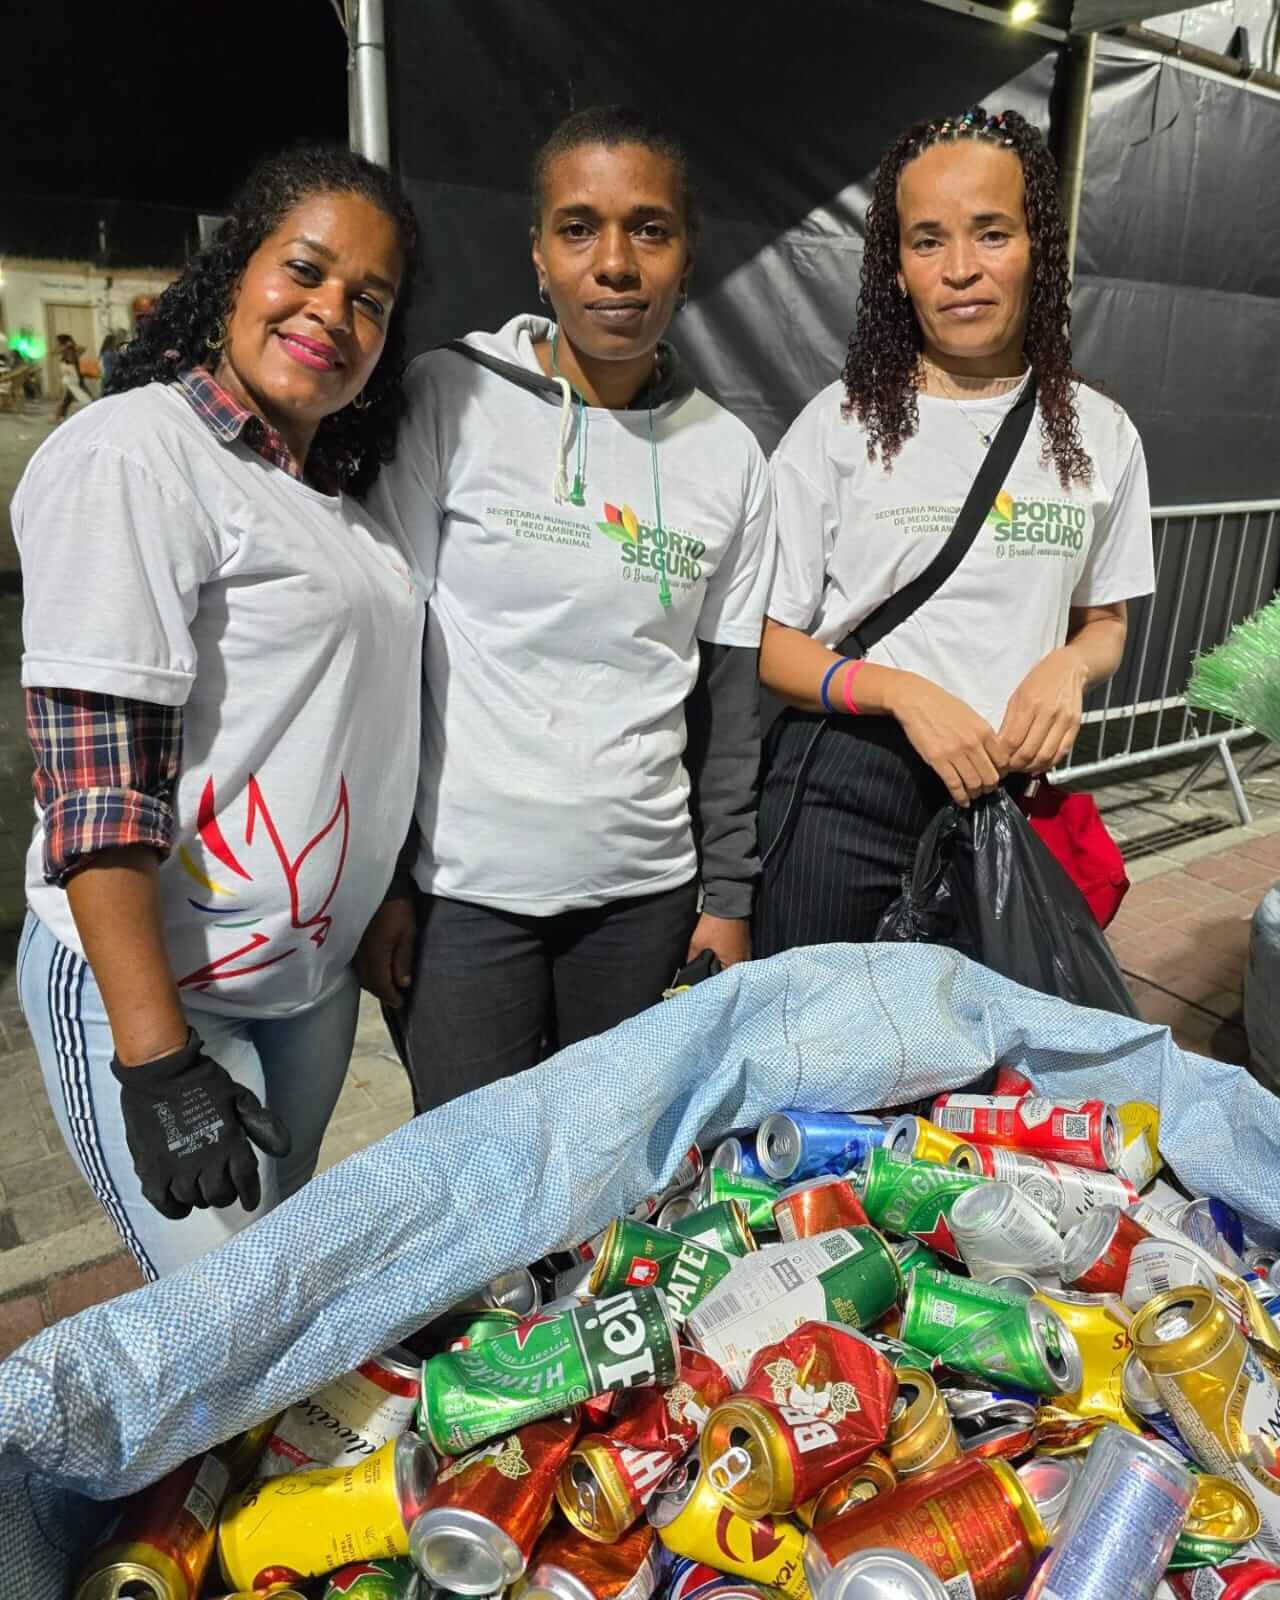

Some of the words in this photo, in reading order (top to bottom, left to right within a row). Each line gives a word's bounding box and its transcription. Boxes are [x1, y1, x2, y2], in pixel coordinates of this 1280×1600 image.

[486, 507, 541, 521] SECRETARIA
[543, 515, 591, 531] MUNICIPAL
[875, 505, 926, 520] SECRETARIA
[894, 517, 907, 526] DE
[908, 515, 931, 524] MEIO
[1012, 502, 1085, 529] PORTO
[506, 517, 519, 528] DE
[521, 520, 543, 531] MEIO
[545, 524, 591, 540] AMBIENTE
[523, 530, 554, 543] CAUSA
[556, 534, 592, 549] ANIMAL
[911, 524, 940, 534] CAUSA
[994, 522, 1083, 551] SEGURO
[637, 525, 706, 560] PORTO
[621, 543, 701, 582] SEGURO
